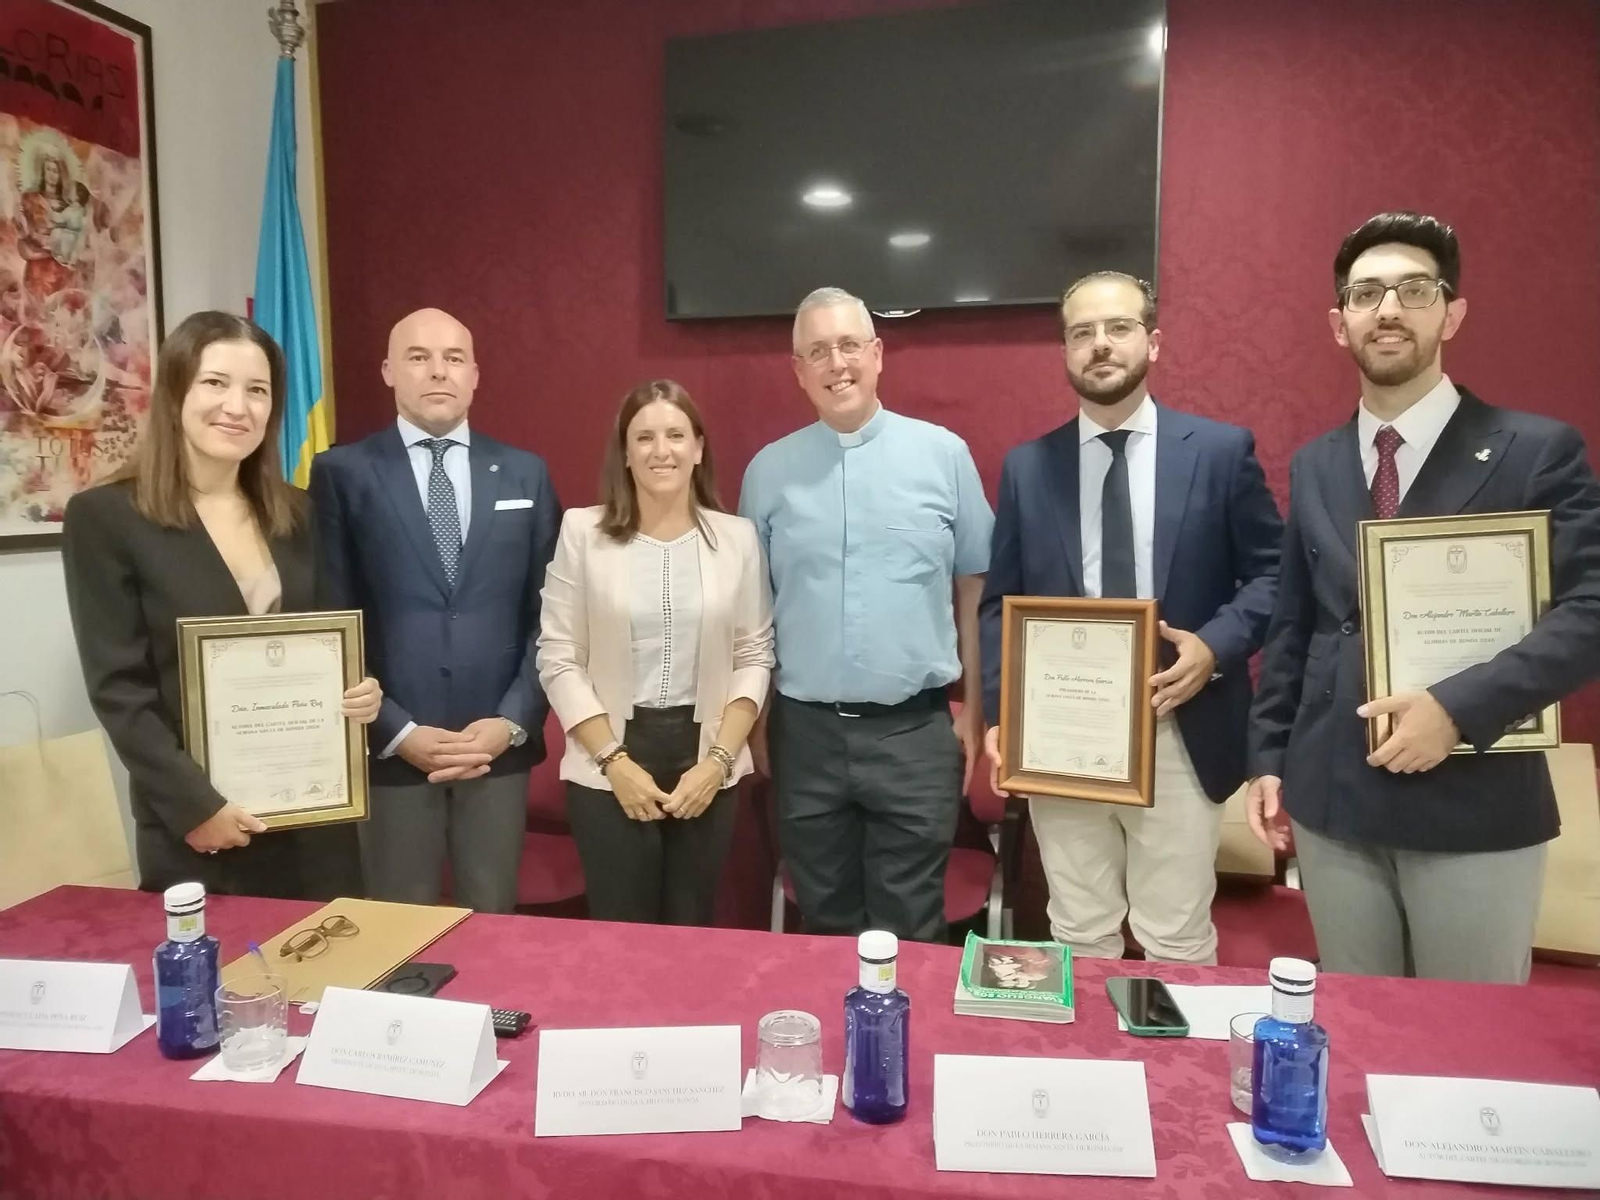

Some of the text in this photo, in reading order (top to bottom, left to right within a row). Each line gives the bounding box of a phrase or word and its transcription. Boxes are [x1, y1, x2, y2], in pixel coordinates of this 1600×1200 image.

[1403, 611, 1418, 620] Don
[1419, 609, 1454, 621] Alejandro
[996, 993, 1064, 1004] EVANGELIO
[331, 1047, 347, 1056] DON
[347, 1049, 376, 1059] CARLOS
[590, 1089, 608, 1098] DON
[609, 1087, 652, 1097] FRANCISCO
[976, 1129, 998, 1138] DON
[999, 1130, 1030, 1139] PABLO
[1032, 1131, 1074, 1141] HERRERA
[1403, 1140, 1427, 1149] DON
[1431, 1142, 1488, 1152] ALEJANDRO
